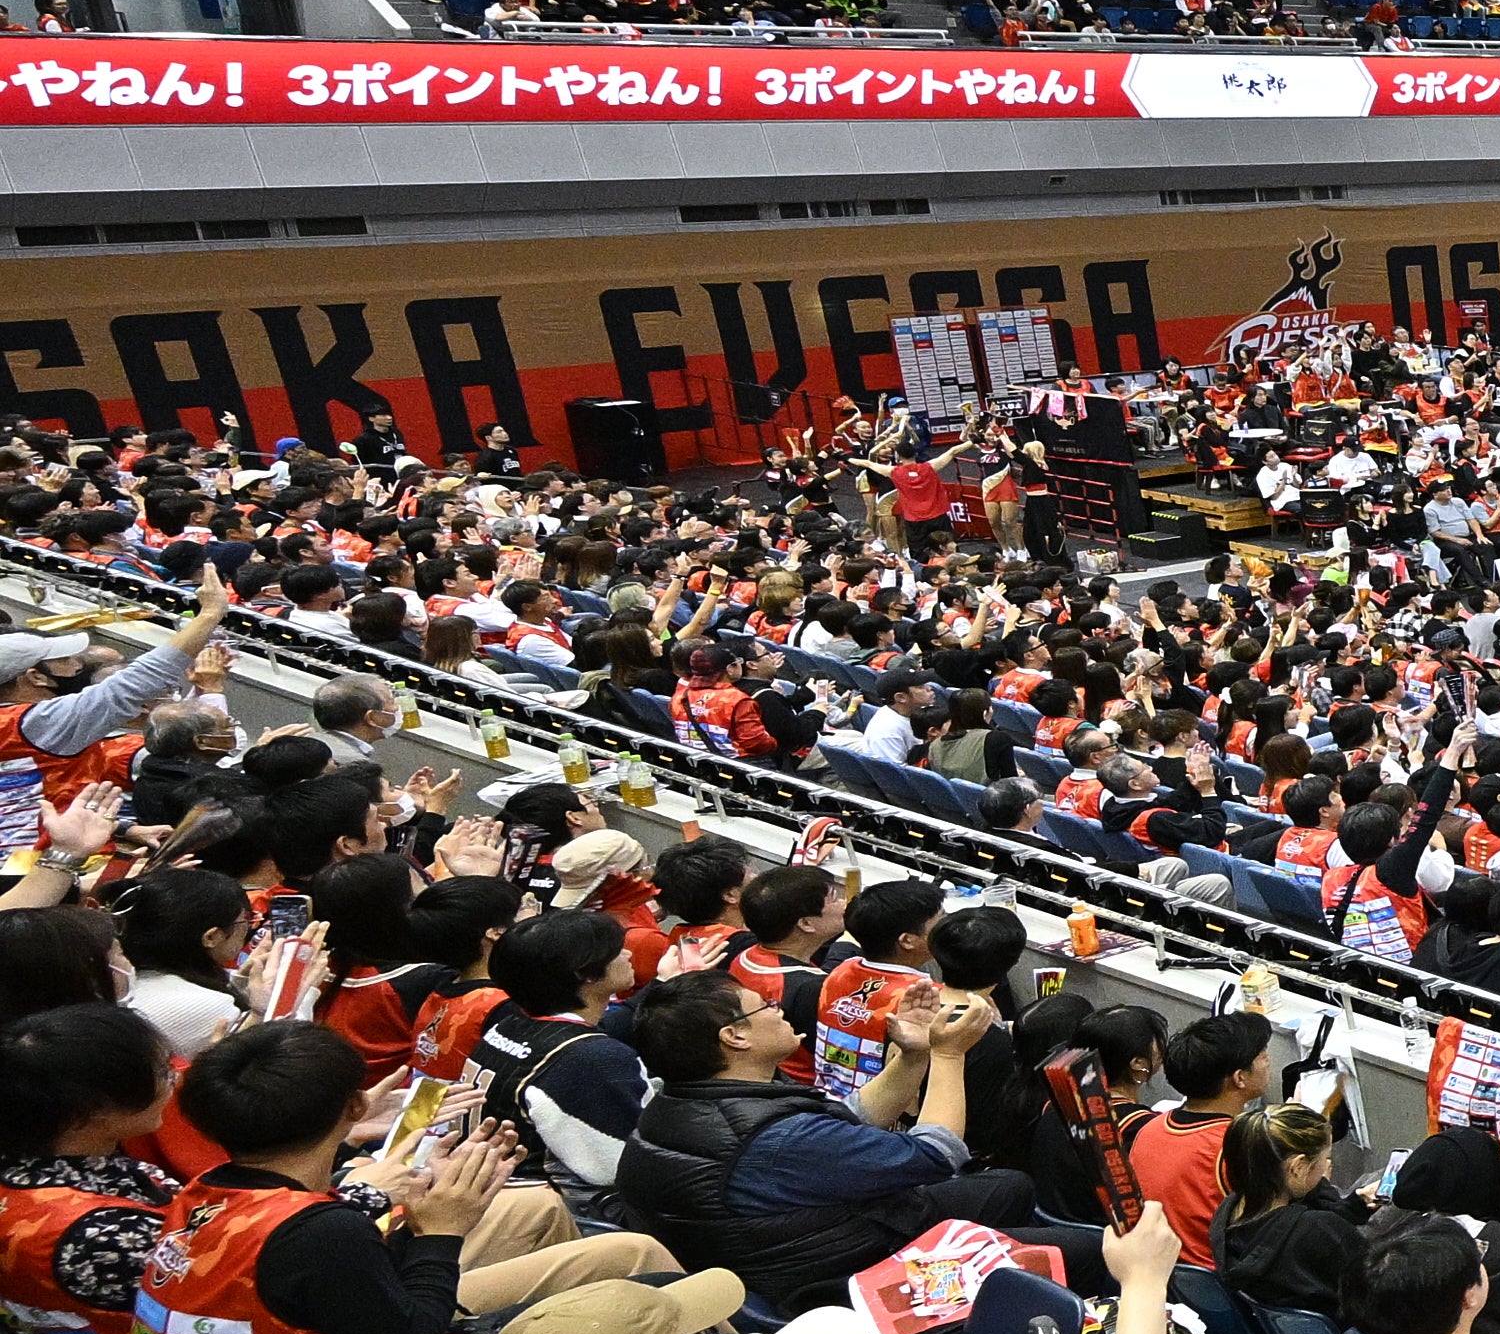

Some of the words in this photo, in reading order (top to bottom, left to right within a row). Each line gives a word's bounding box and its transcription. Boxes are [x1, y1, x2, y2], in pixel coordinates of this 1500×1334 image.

[0, 61, 243, 107] やねん！
[1221, 72, 1287, 98] 桃太郎
[1281, 312, 1330, 331] OSAKA
